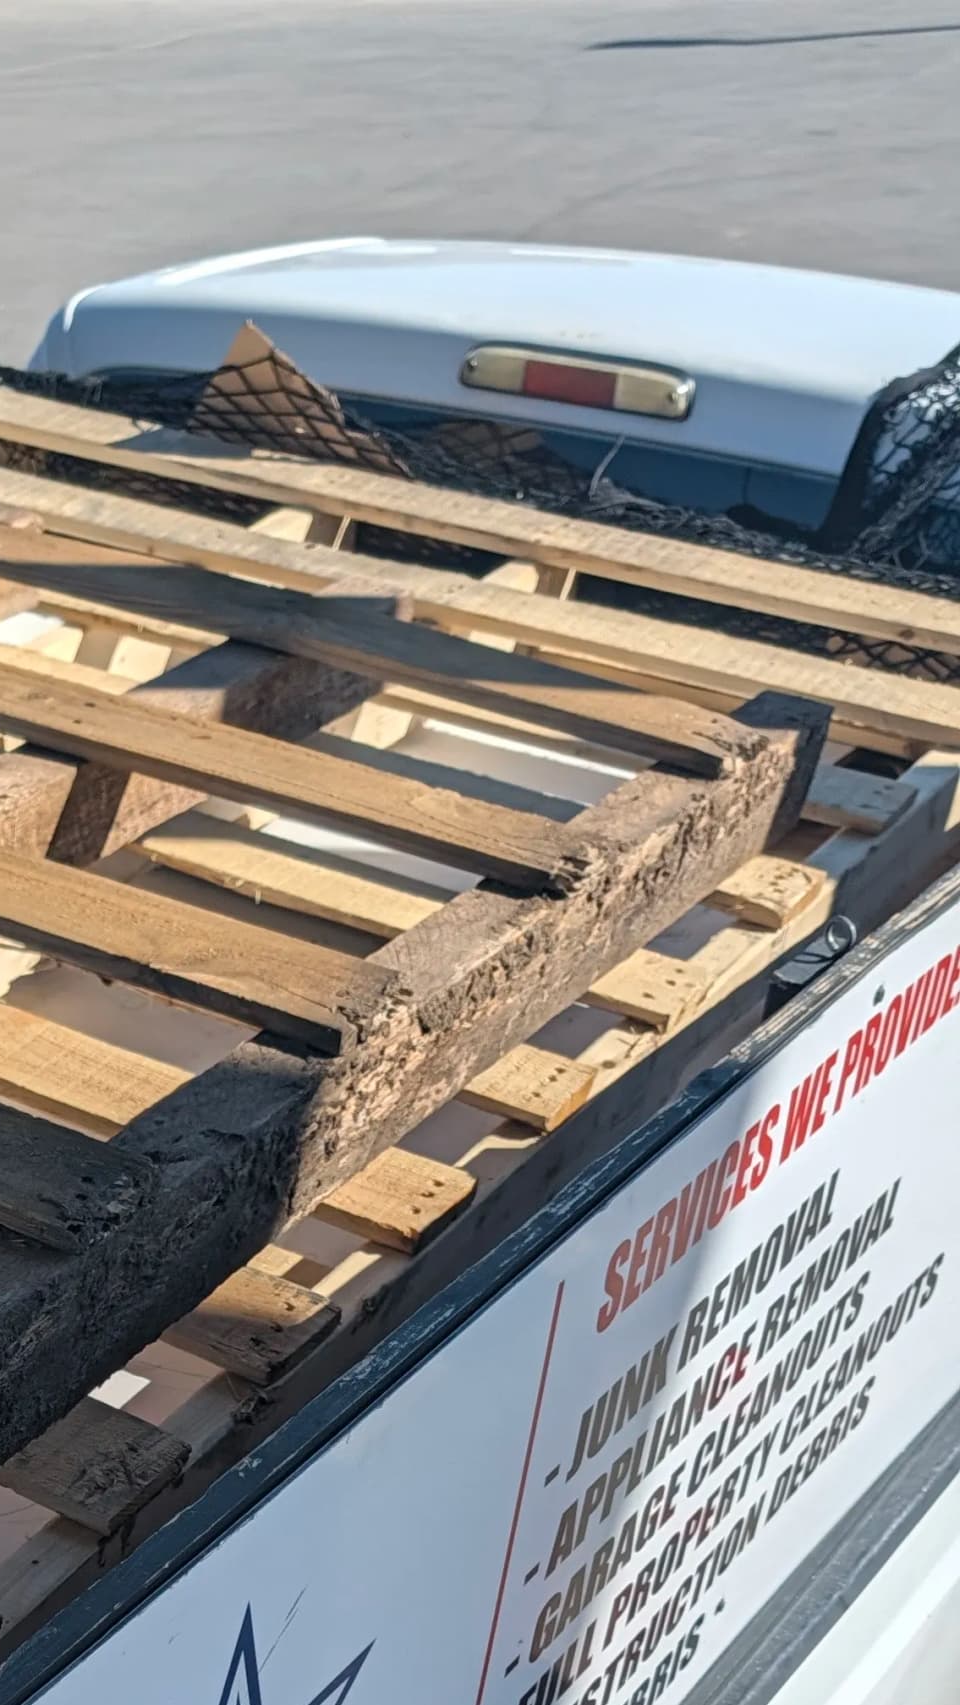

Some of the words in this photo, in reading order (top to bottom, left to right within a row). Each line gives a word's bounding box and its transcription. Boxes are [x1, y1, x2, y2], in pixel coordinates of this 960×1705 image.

[565, 1322, 680, 1483] JUNK
[676, 1166, 841, 1374] REMOVAL
[596, 1103, 781, 1334] SERVICES
[779, 1048, 840, 1166] WE
[528, 1459, 688, 1664] GARAGE
[686, 1270, 872, 1498] CLEANOUTS
[544, 1320, 758, 1581] APPLIANCE
[755, 1176, 902, 1365] REMOVAL
[602, 1417, 783, 1652] PROPERTY
[779, 1251, 946, 1456] CLEANOUTS
[764, 1375, 878, 1526] DEBRIS
